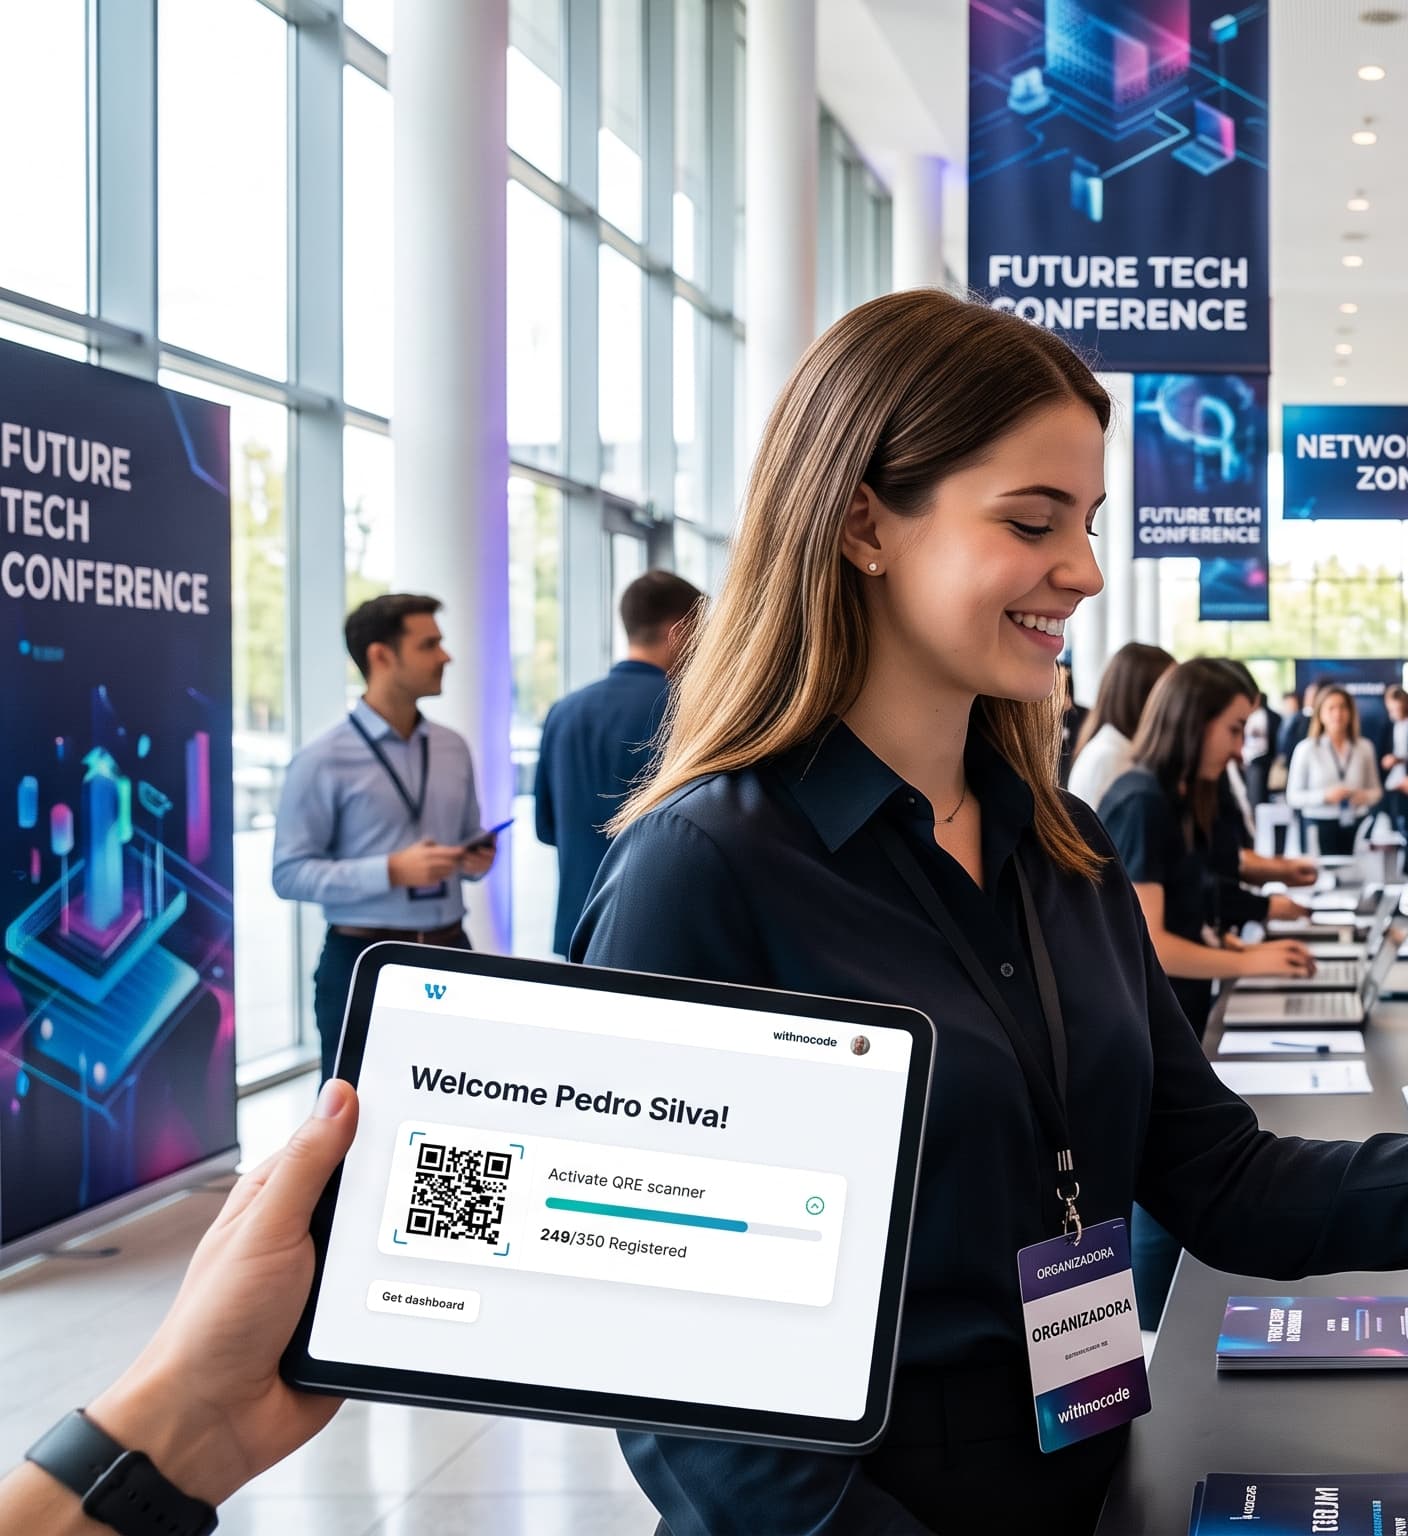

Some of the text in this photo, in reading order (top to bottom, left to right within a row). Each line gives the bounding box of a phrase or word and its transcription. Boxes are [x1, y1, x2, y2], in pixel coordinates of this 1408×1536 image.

[988, 255, 1248, 289] FUTURE TECH
[1, 422, 132, 492] FUTURE
[0, 486, 90, 543] TECH
[1138, 506, 1261, 524] FUTURE TECH
[1138, 526, 1261, 544] CONFERENCE
[1, 551, 209, 614] CONFERENCE
[773, 1030, 838, 1047] withnocode
[411, 1065, 730, 1130] Welcome Pedro Silva!
[548, 1168, 706, 1200] Activate QRE scanner
[540, 1228, 688, 1259] 249/350 Registered
[1036, 1246, 1115, 1281] ORGANIZADORA
[382, 1291, 465, 1311] Get dashboard
[1032, 1298, 1132, 1343] ORGANIZADORA
[1058, 1386, 1130, 1424] withnocode
